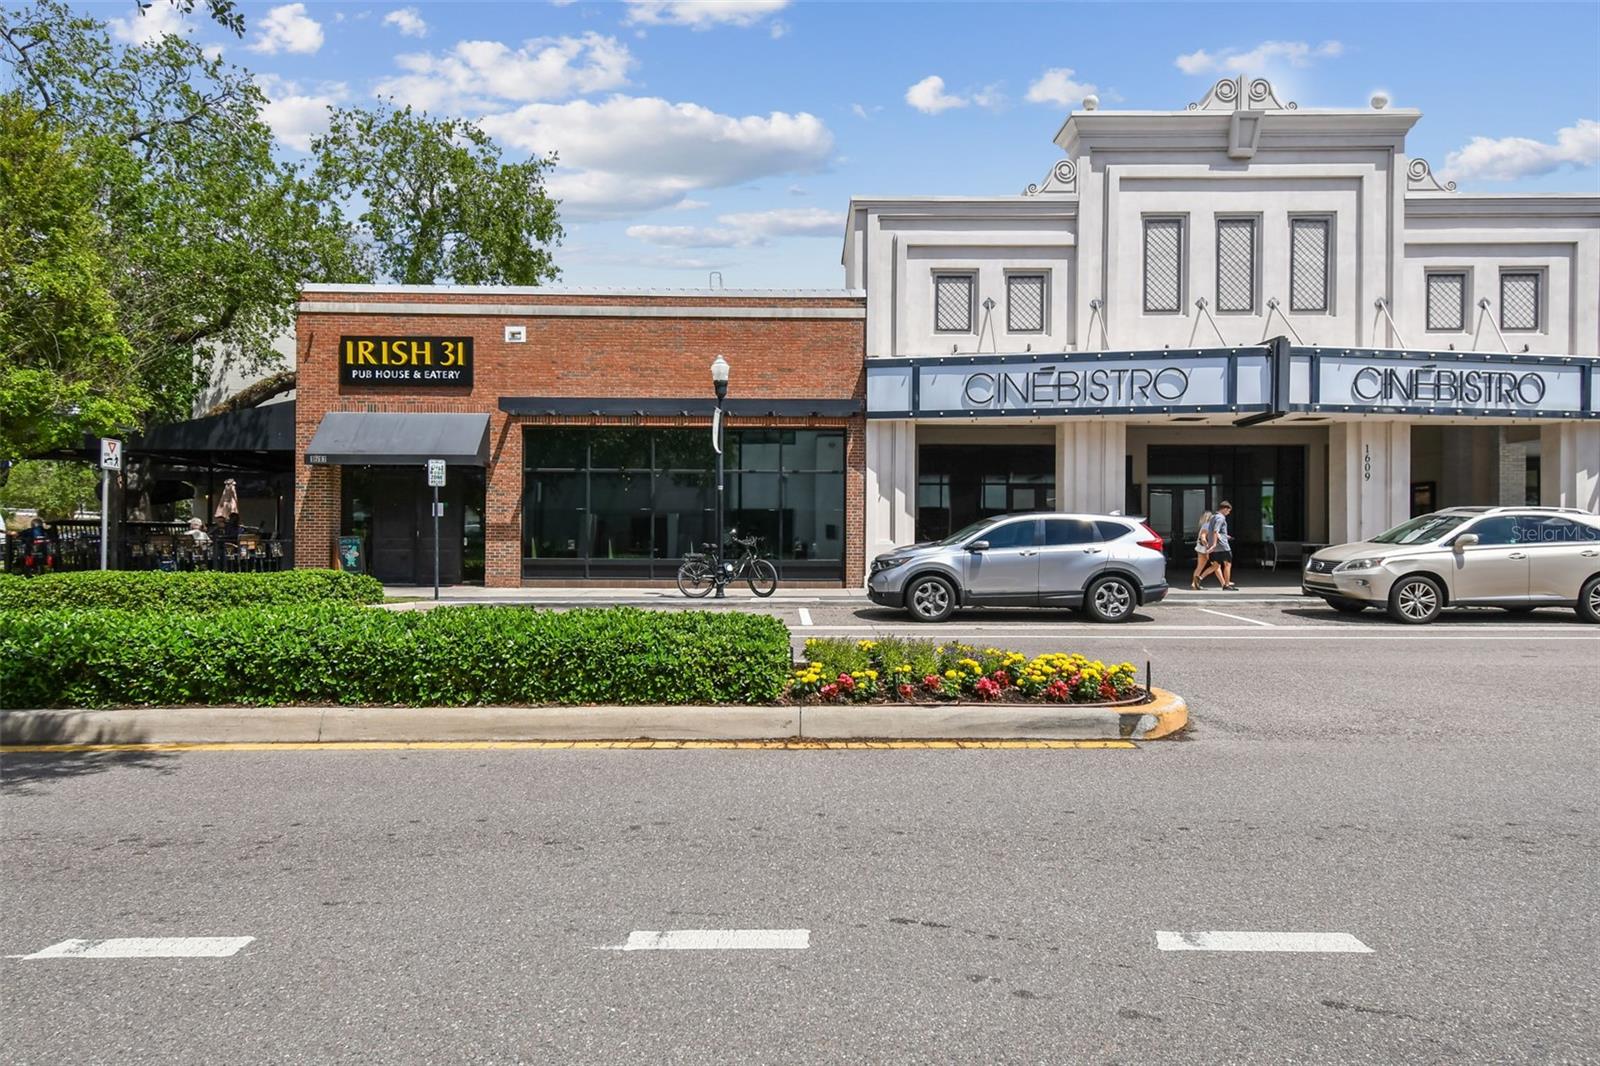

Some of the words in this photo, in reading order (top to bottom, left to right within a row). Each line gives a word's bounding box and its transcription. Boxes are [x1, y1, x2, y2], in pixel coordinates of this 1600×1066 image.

[346, 340, 432, 366] IRISH
[440, 341, 465, 366] 31
[352, 370, 373, 379] PUB
[375, 370, 410, 379] HOUSE
[413, 370, 422, 379] &
[424, 370, 461, 380] EATERY
[965, 366, 1189, 404] CINÉBISTRO
[1353, 364, 1546, 405] CINÉBISTRO
